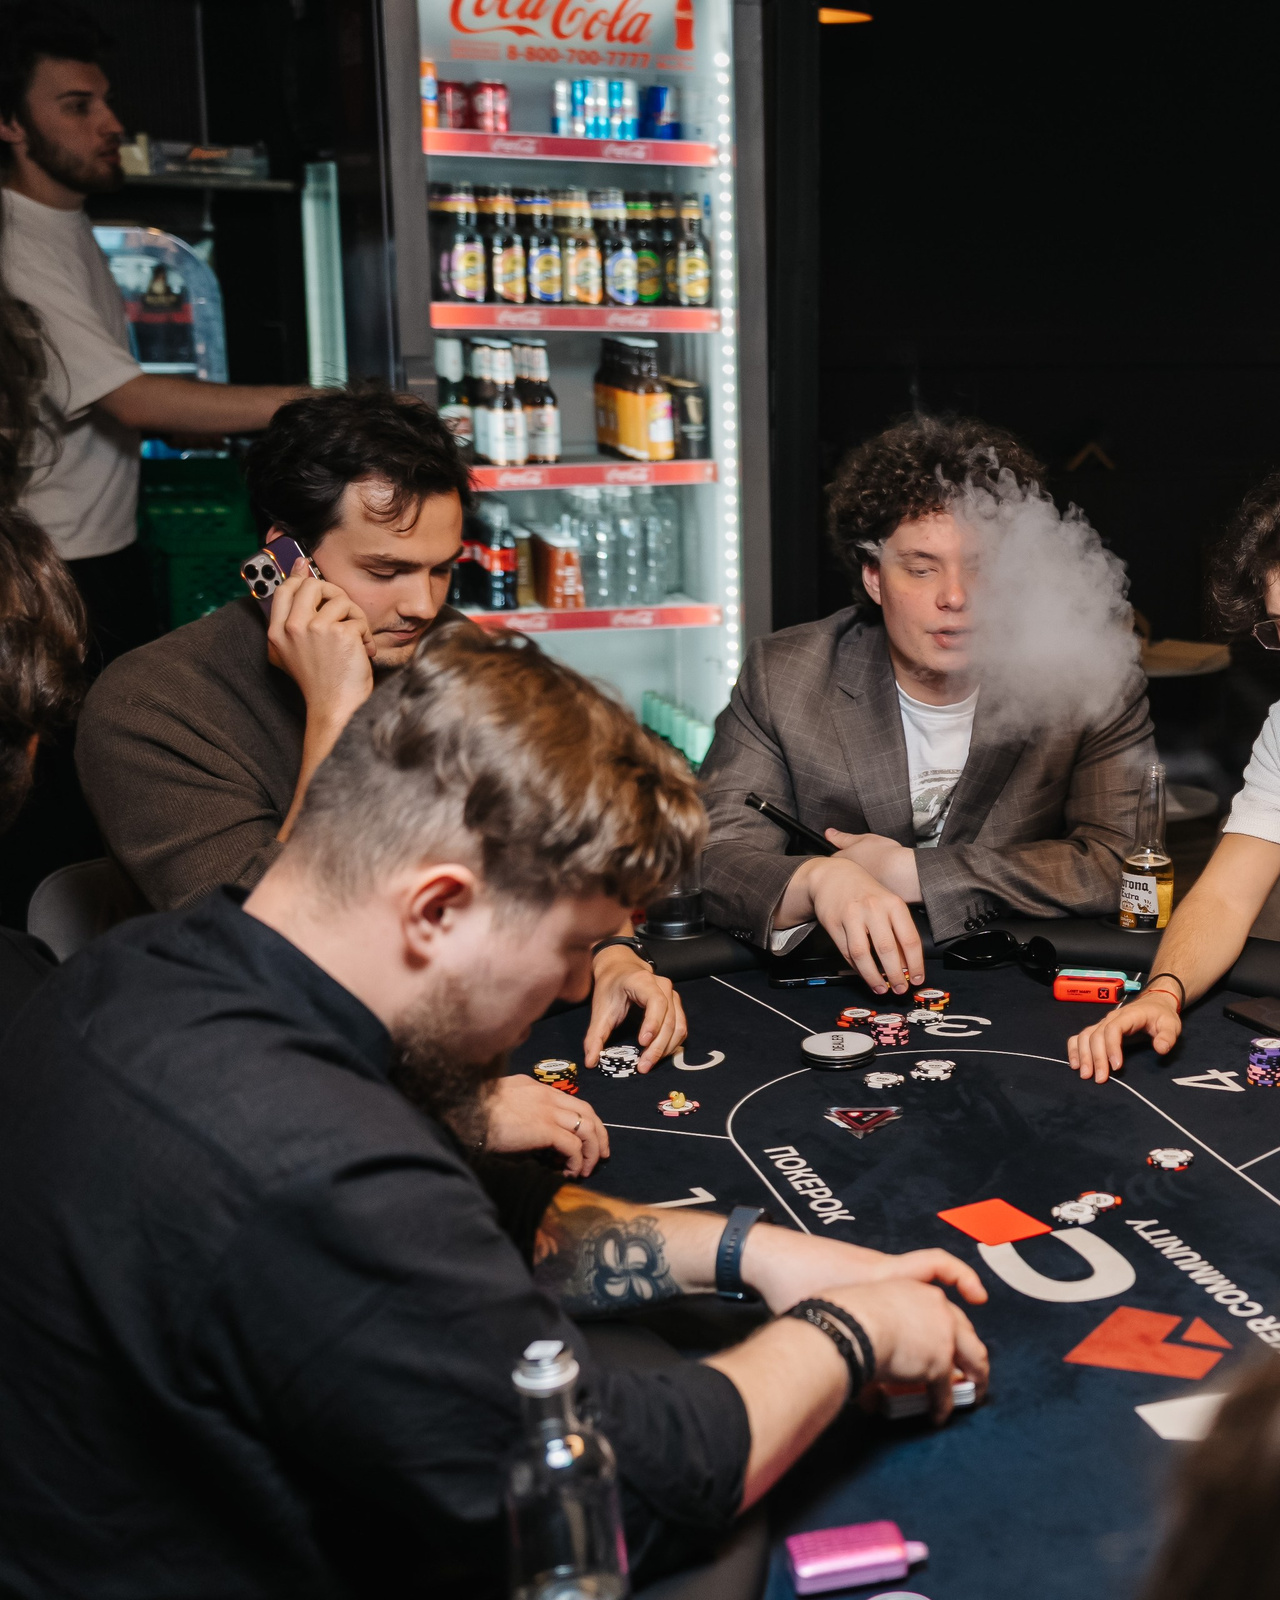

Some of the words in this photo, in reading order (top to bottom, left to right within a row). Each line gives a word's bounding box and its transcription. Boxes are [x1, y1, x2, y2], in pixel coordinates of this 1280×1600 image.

[831, 1034, 844, 1051] DEALER
[1171, 1068, 1246, 1092] 4
[763, 1145, 856, 1226] ПОКЕРОК
[1125, 1219, 1264, 1318] COMMUNITY
